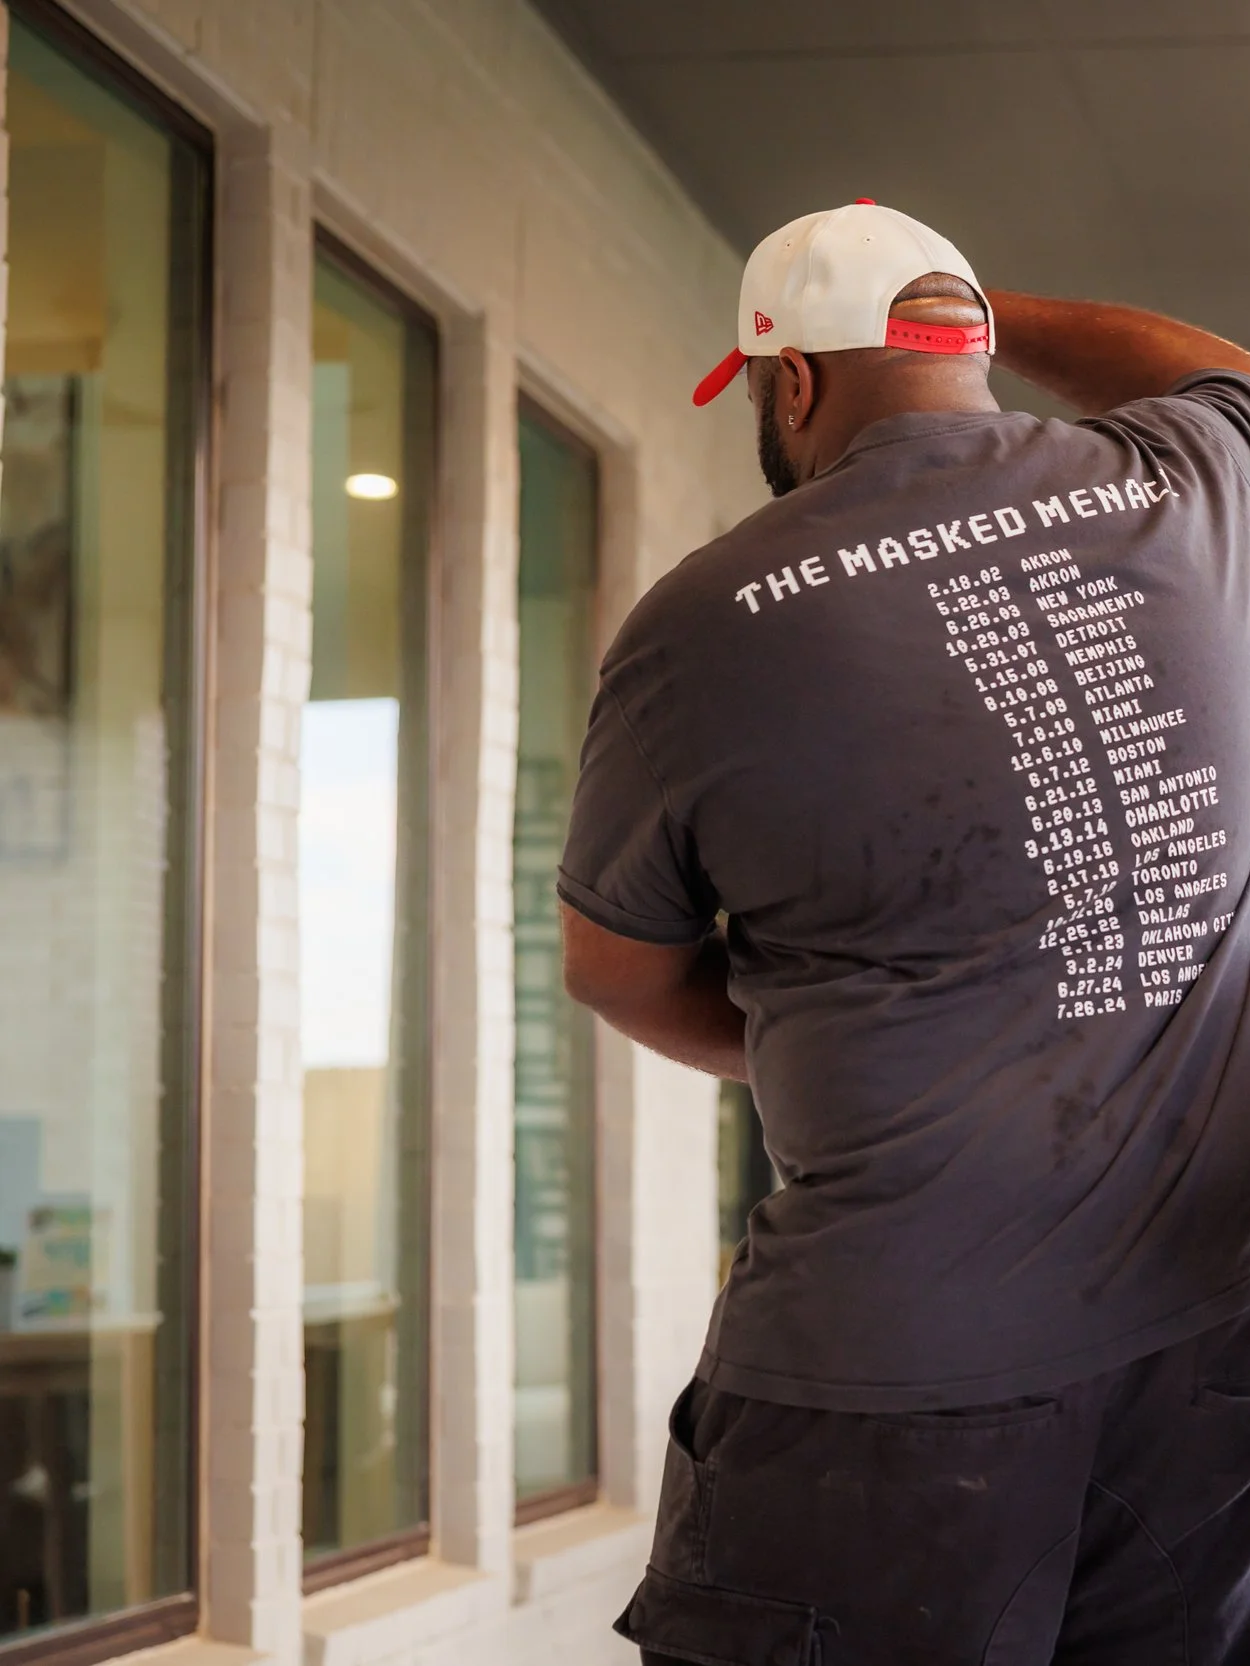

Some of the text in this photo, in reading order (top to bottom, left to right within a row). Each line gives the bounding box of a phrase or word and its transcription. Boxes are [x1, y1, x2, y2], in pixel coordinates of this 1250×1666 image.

[734, 555, 830, 614] THE
[836, 508, 1029, 579] MASKED
[927, 549, 1073, 598] 2.18.02 AKRON
[936, 564, 1082, 616] 5.22.03 AKRON
[945, 576, 1119, 635] 6.26.03 NEW YORK
[946, 590, 1145, 657] 10.29.03 SACRAMENTO
[965, 616, 1128, 674] 5.31.07 DETROIT
[974, 636, 1137, 693] 1.15.08 MEMPHIS
[984, 655, 1145, 711] 8.10.08 BEIJING
[1004, 674, 1155, 727] 5.7.09 ATLANTA
[1012, 699, 1143, 748] 7.8.10 MIAMI
[1010, 709, 1187, 771] 12.6.10 MILWAUKEE
[1028, 737, 1167, 788] 6.7.12 BOSTON
[1025, 759, 1163, 812] 6.21.12 MIAMI
[1032, 766, 1217, 832] 6.20.13 SAN ANTONIO
[1024, 787, 1219, 858] 3.13.14 CHARLOTTE
[1043, 818, 1194, 875] 6.19.16 OAKLAND
[1047, 830, 1227, 896] 2.17.18 LOS ANGELES
[1131, 860, 1197, 886] TORONTO
[1134, 888, 1164, 905] LOS
[1174, 873, 1227, 899] ANGELES
[1039, 904, 1190, 949] 12.25.22 DALLAS
[1062, 912, 1234, 956] 2.7.23 OKLAHOMA CIT
[1058, 977, 1122, 998] 6.27.24
[1141, 972, 1170, 987] LOS
[1066, 945, 1193, 975] 3.2.24 DENVER
[1058, 989, 1182, 1019] 7.26.24 PARIS
